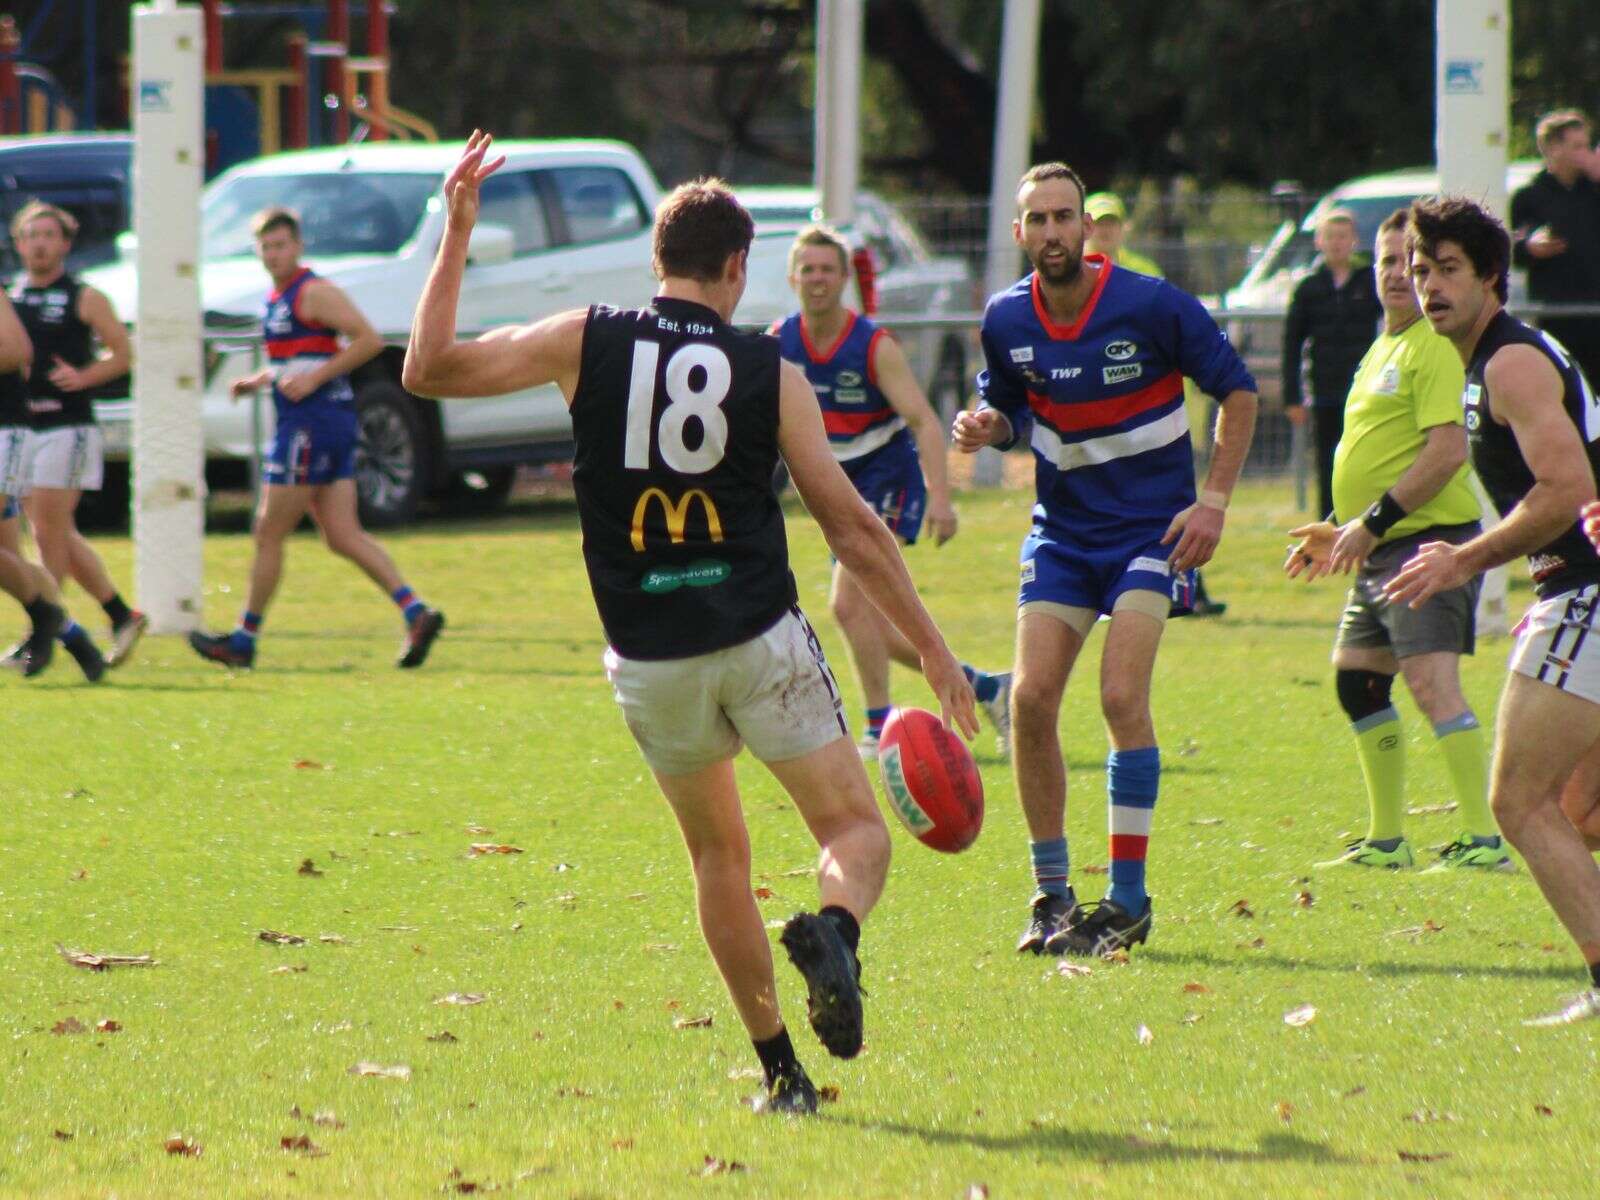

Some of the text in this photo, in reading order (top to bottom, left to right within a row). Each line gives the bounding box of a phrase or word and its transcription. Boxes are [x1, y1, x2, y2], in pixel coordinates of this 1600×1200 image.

[657, 317, 714, 335] Est. 1934
[1051, 368, 1082, 379] TWP
[1106, 366, 1138, 377] WAW
[625, 340, 731, 474] 18
[648, 567, 723, 586] Speavers
